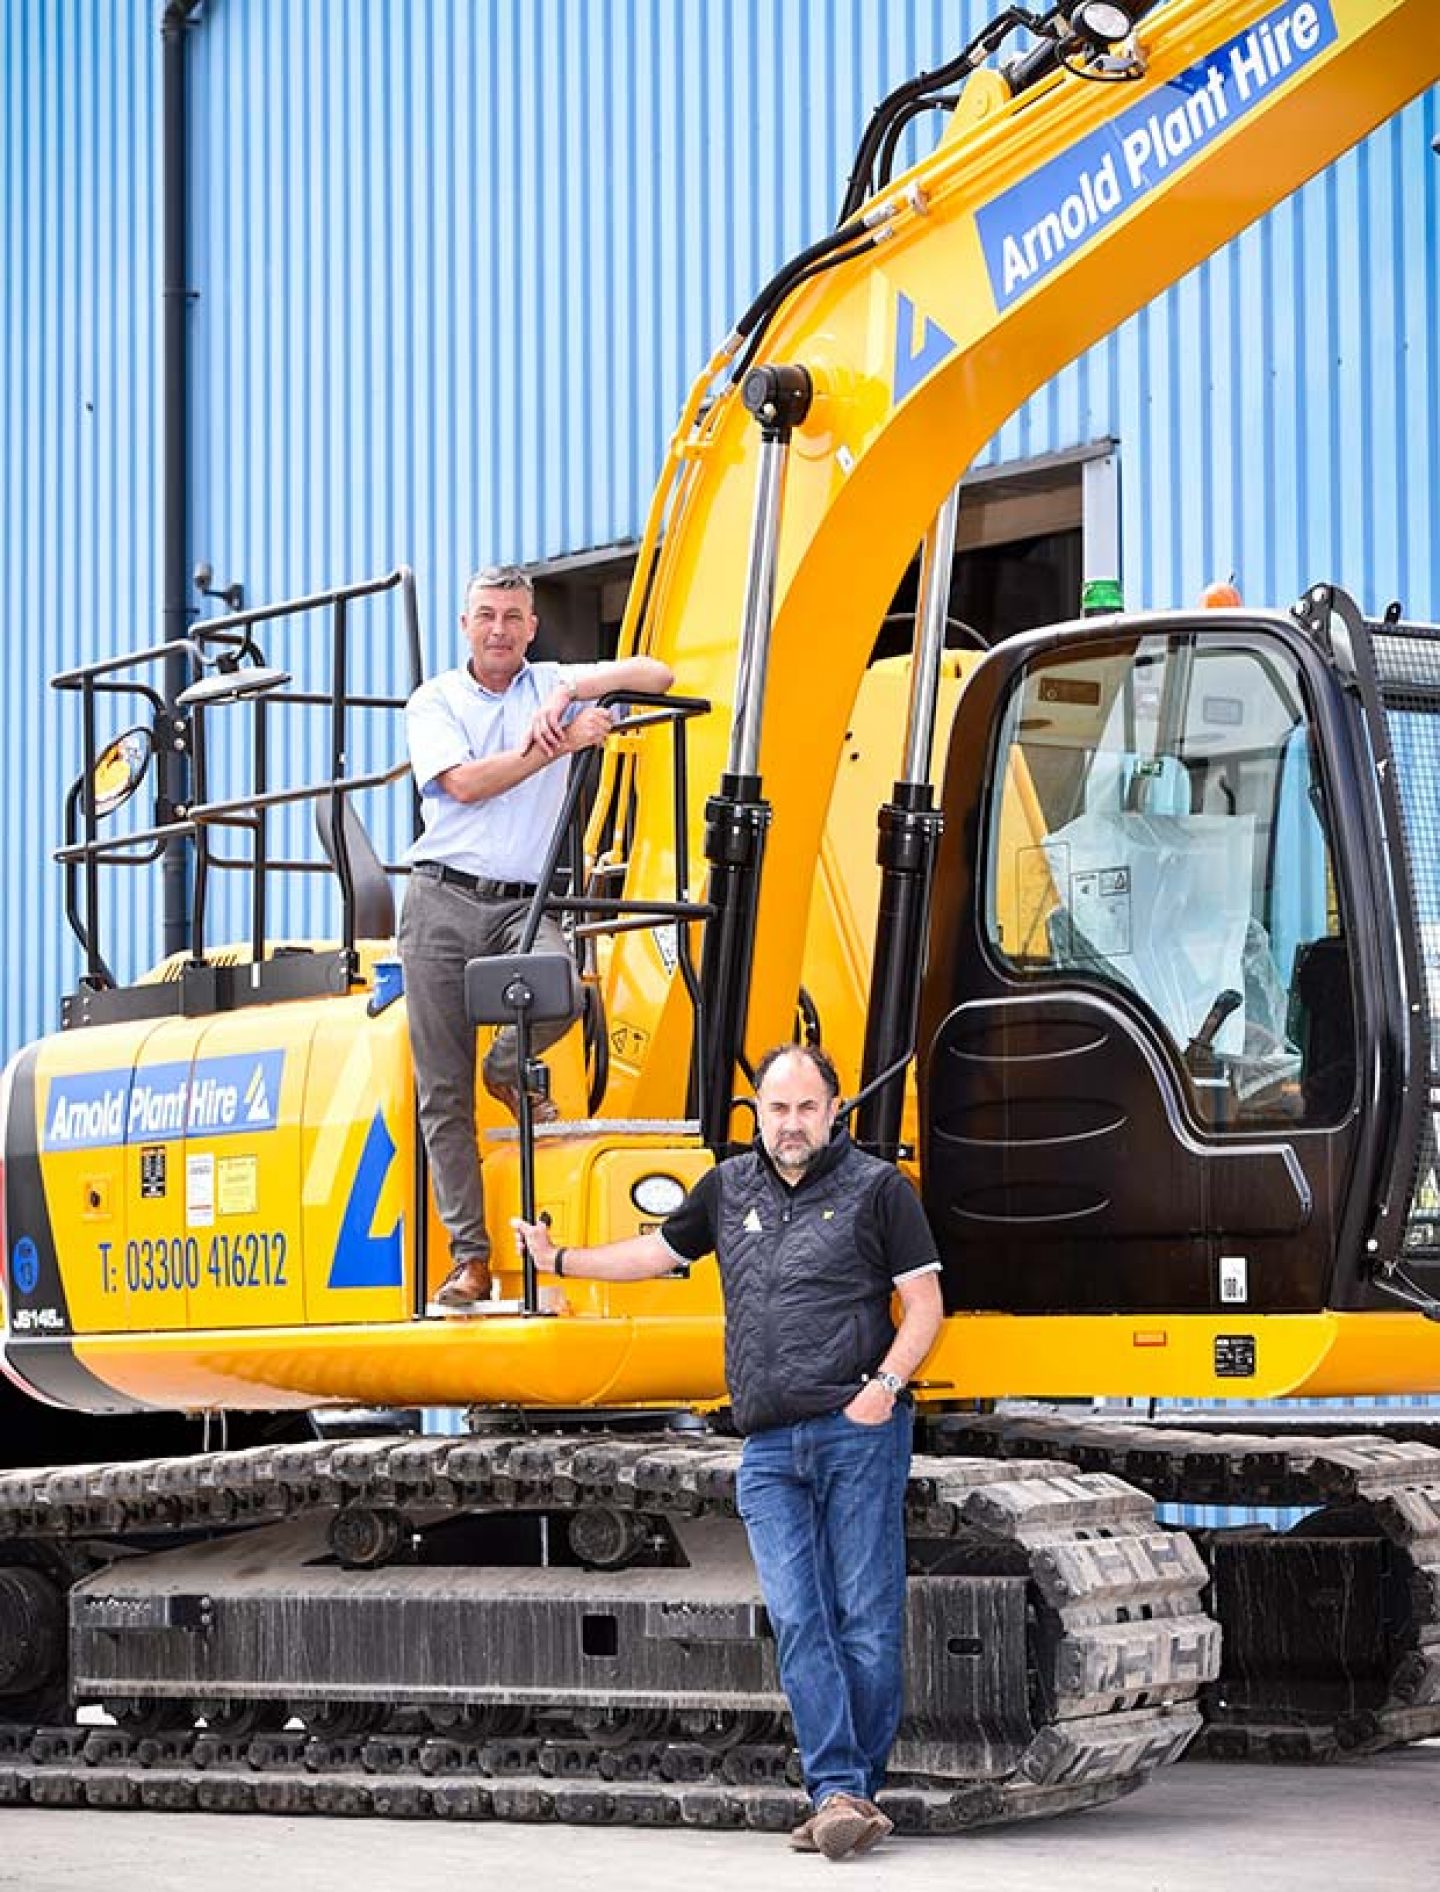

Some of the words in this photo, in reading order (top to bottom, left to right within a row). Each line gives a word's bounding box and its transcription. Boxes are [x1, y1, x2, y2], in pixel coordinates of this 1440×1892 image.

[1001, 153, 1122, 295] Arnold
[1122, 66, 1229, 188] Plant
[1230, 2, 1320, 100] Hire
[50, 1089, 124, 1141] Arnold
[128, 1081, 186, 1134] Plant
[187, 1077, 238, 1127] Hire
[99, 1242, 117, 1294] T:
[127, 1236, 200, 1292] 03300
[208, 1232, 288, 1288] 416212
